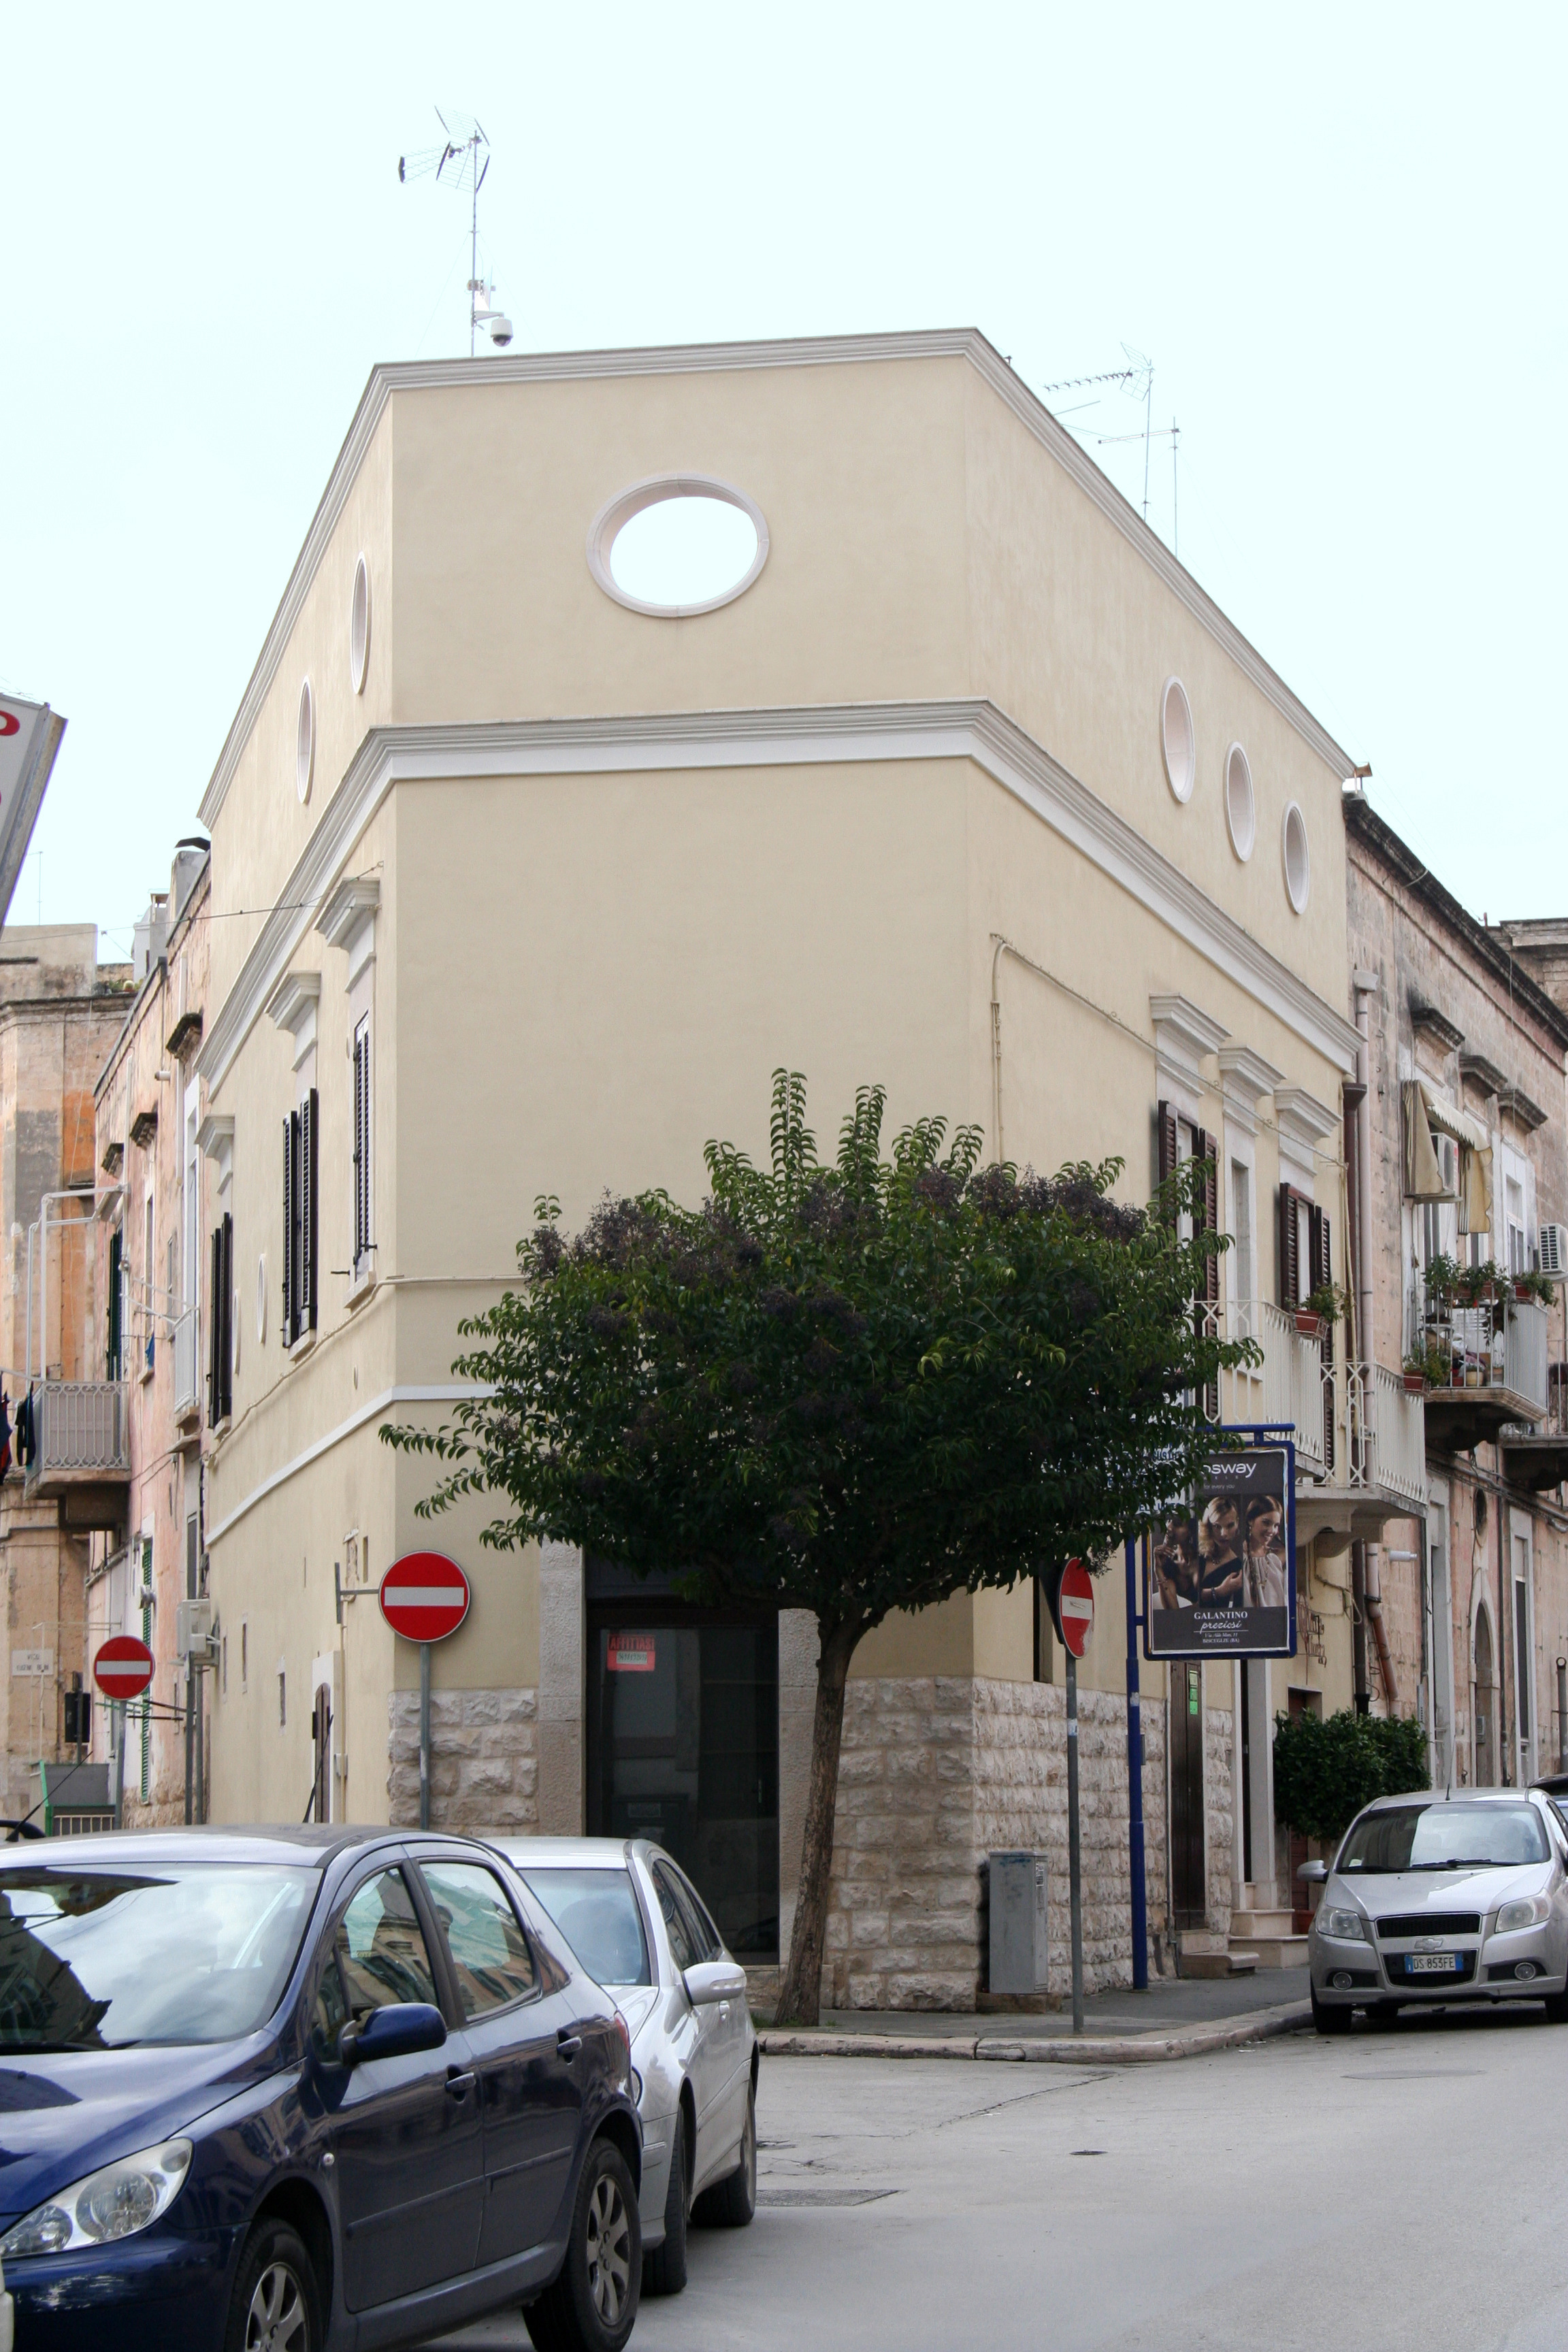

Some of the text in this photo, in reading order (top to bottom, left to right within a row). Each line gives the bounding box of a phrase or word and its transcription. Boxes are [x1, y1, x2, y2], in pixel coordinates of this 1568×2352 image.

[1194, 1611, 1248, 1620] GALANTINO
[1200, 1620, 1242, 1634] preziosi
[609, 1636, 655, 1651] AFFITTASI
